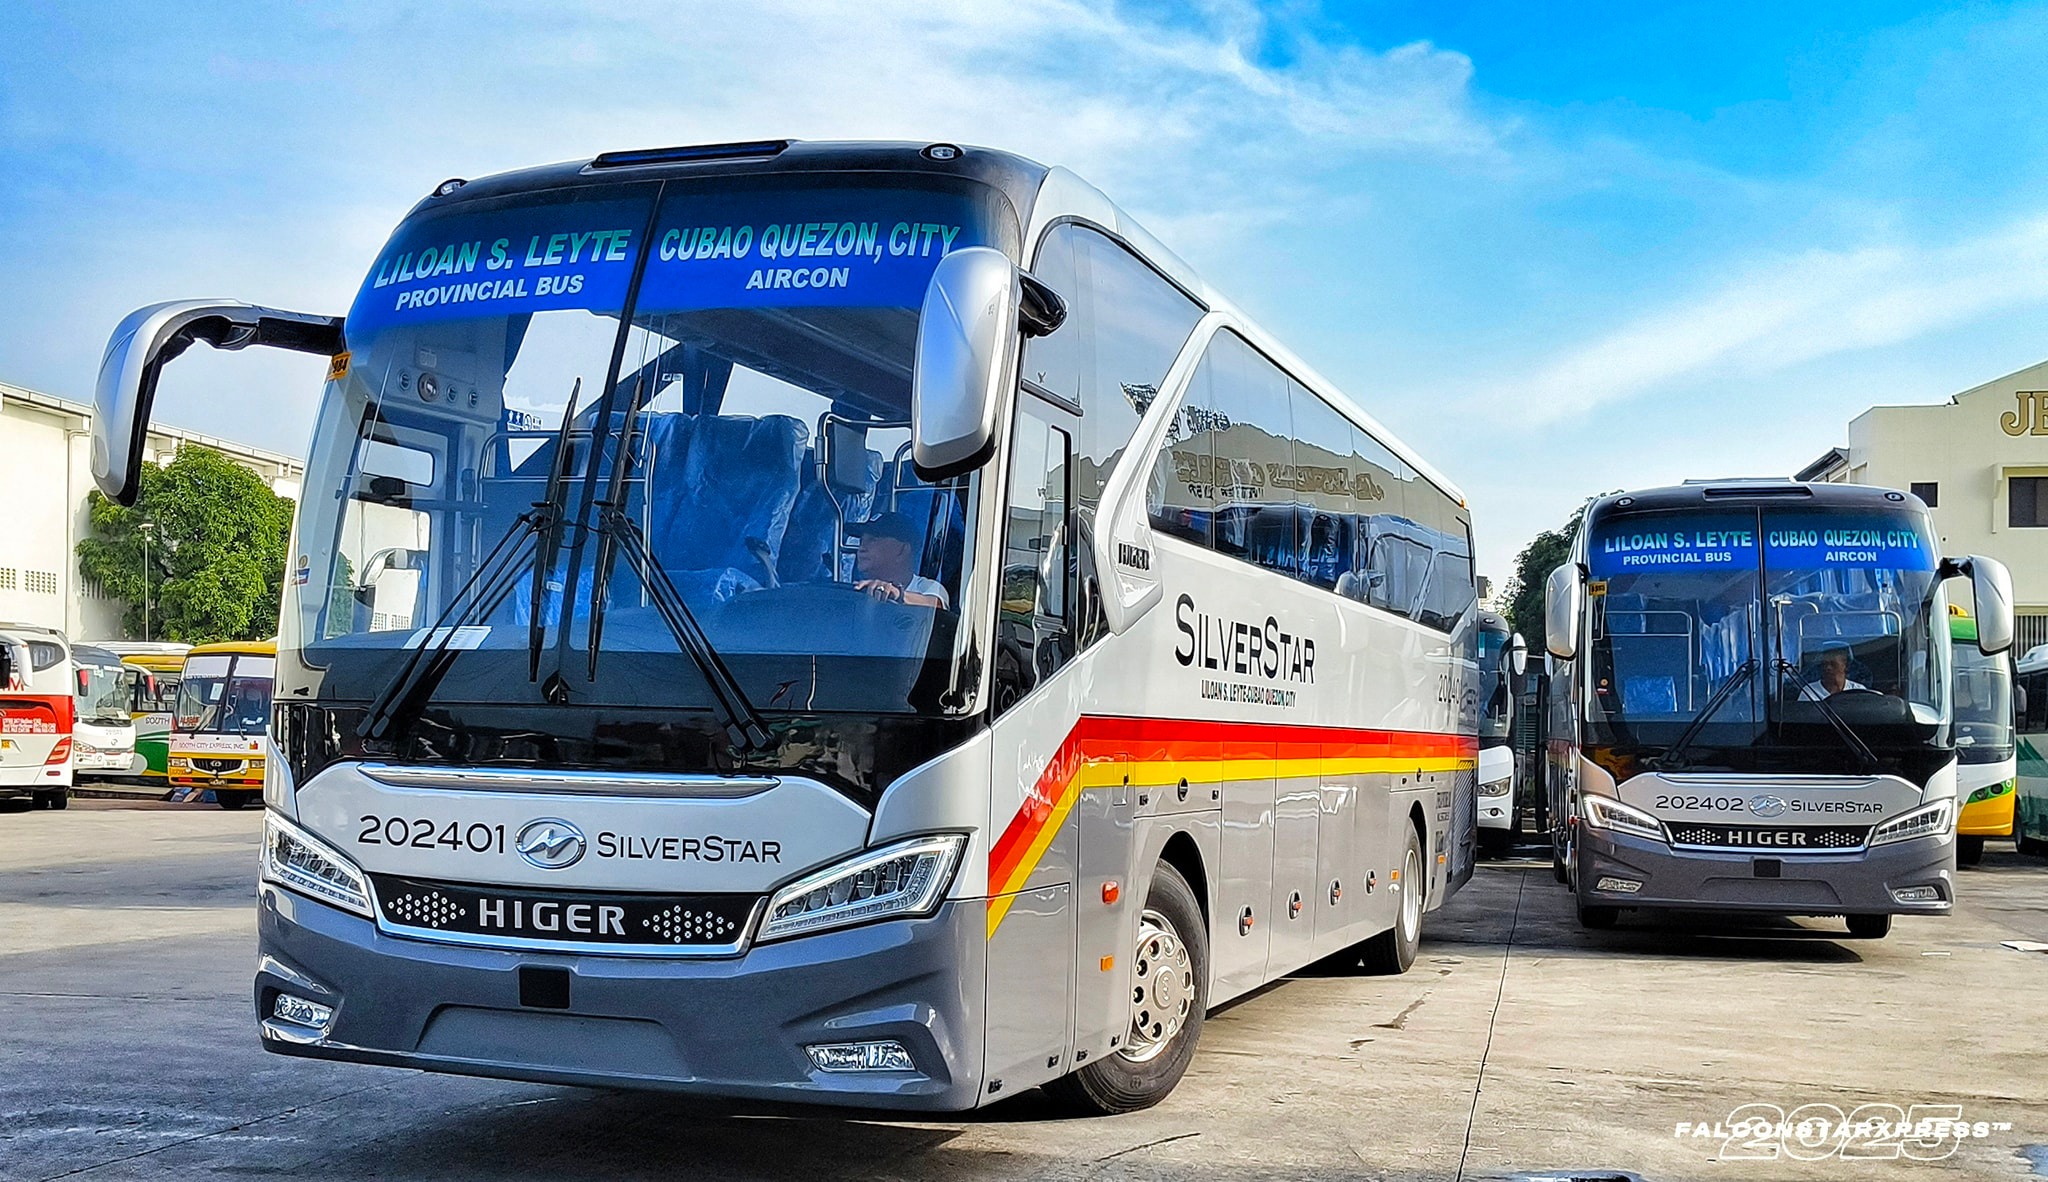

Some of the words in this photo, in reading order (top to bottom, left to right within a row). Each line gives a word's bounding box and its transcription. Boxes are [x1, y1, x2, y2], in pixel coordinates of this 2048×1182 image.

[659, 225, 754, 261] CUBAO
[888, 222, 960, 258] CITY
[374, 241, 481, 289] LILOAN
[486, 238, 513, 270] S.
[524, 229, 633, 267] LEYTE
[746, 267, 849, 289] AIRCON
[395, 278, 528, 311] PROVINCIAL
[535, 275, 584, 297] BUS
[1604, 532, 1668, 553] LILOAN
[1673, 533, 1690, 549] S.
[1696, 531, 1753, 548] LEYTE
[1769, 531, 1818, 548] CUBAO
[1622, 552, 1702, 566] PROVINCIAL
[1705, 551, 1732, 563] BUS
[1824, 551, 1877, 563] AIRCON
[1655, 795, 1744, 812] 202402
[357, 814, 505, 854] 202401
[1727, 830, 1807, 846] HIGER
[479, 898, 626, 936] HIGER
